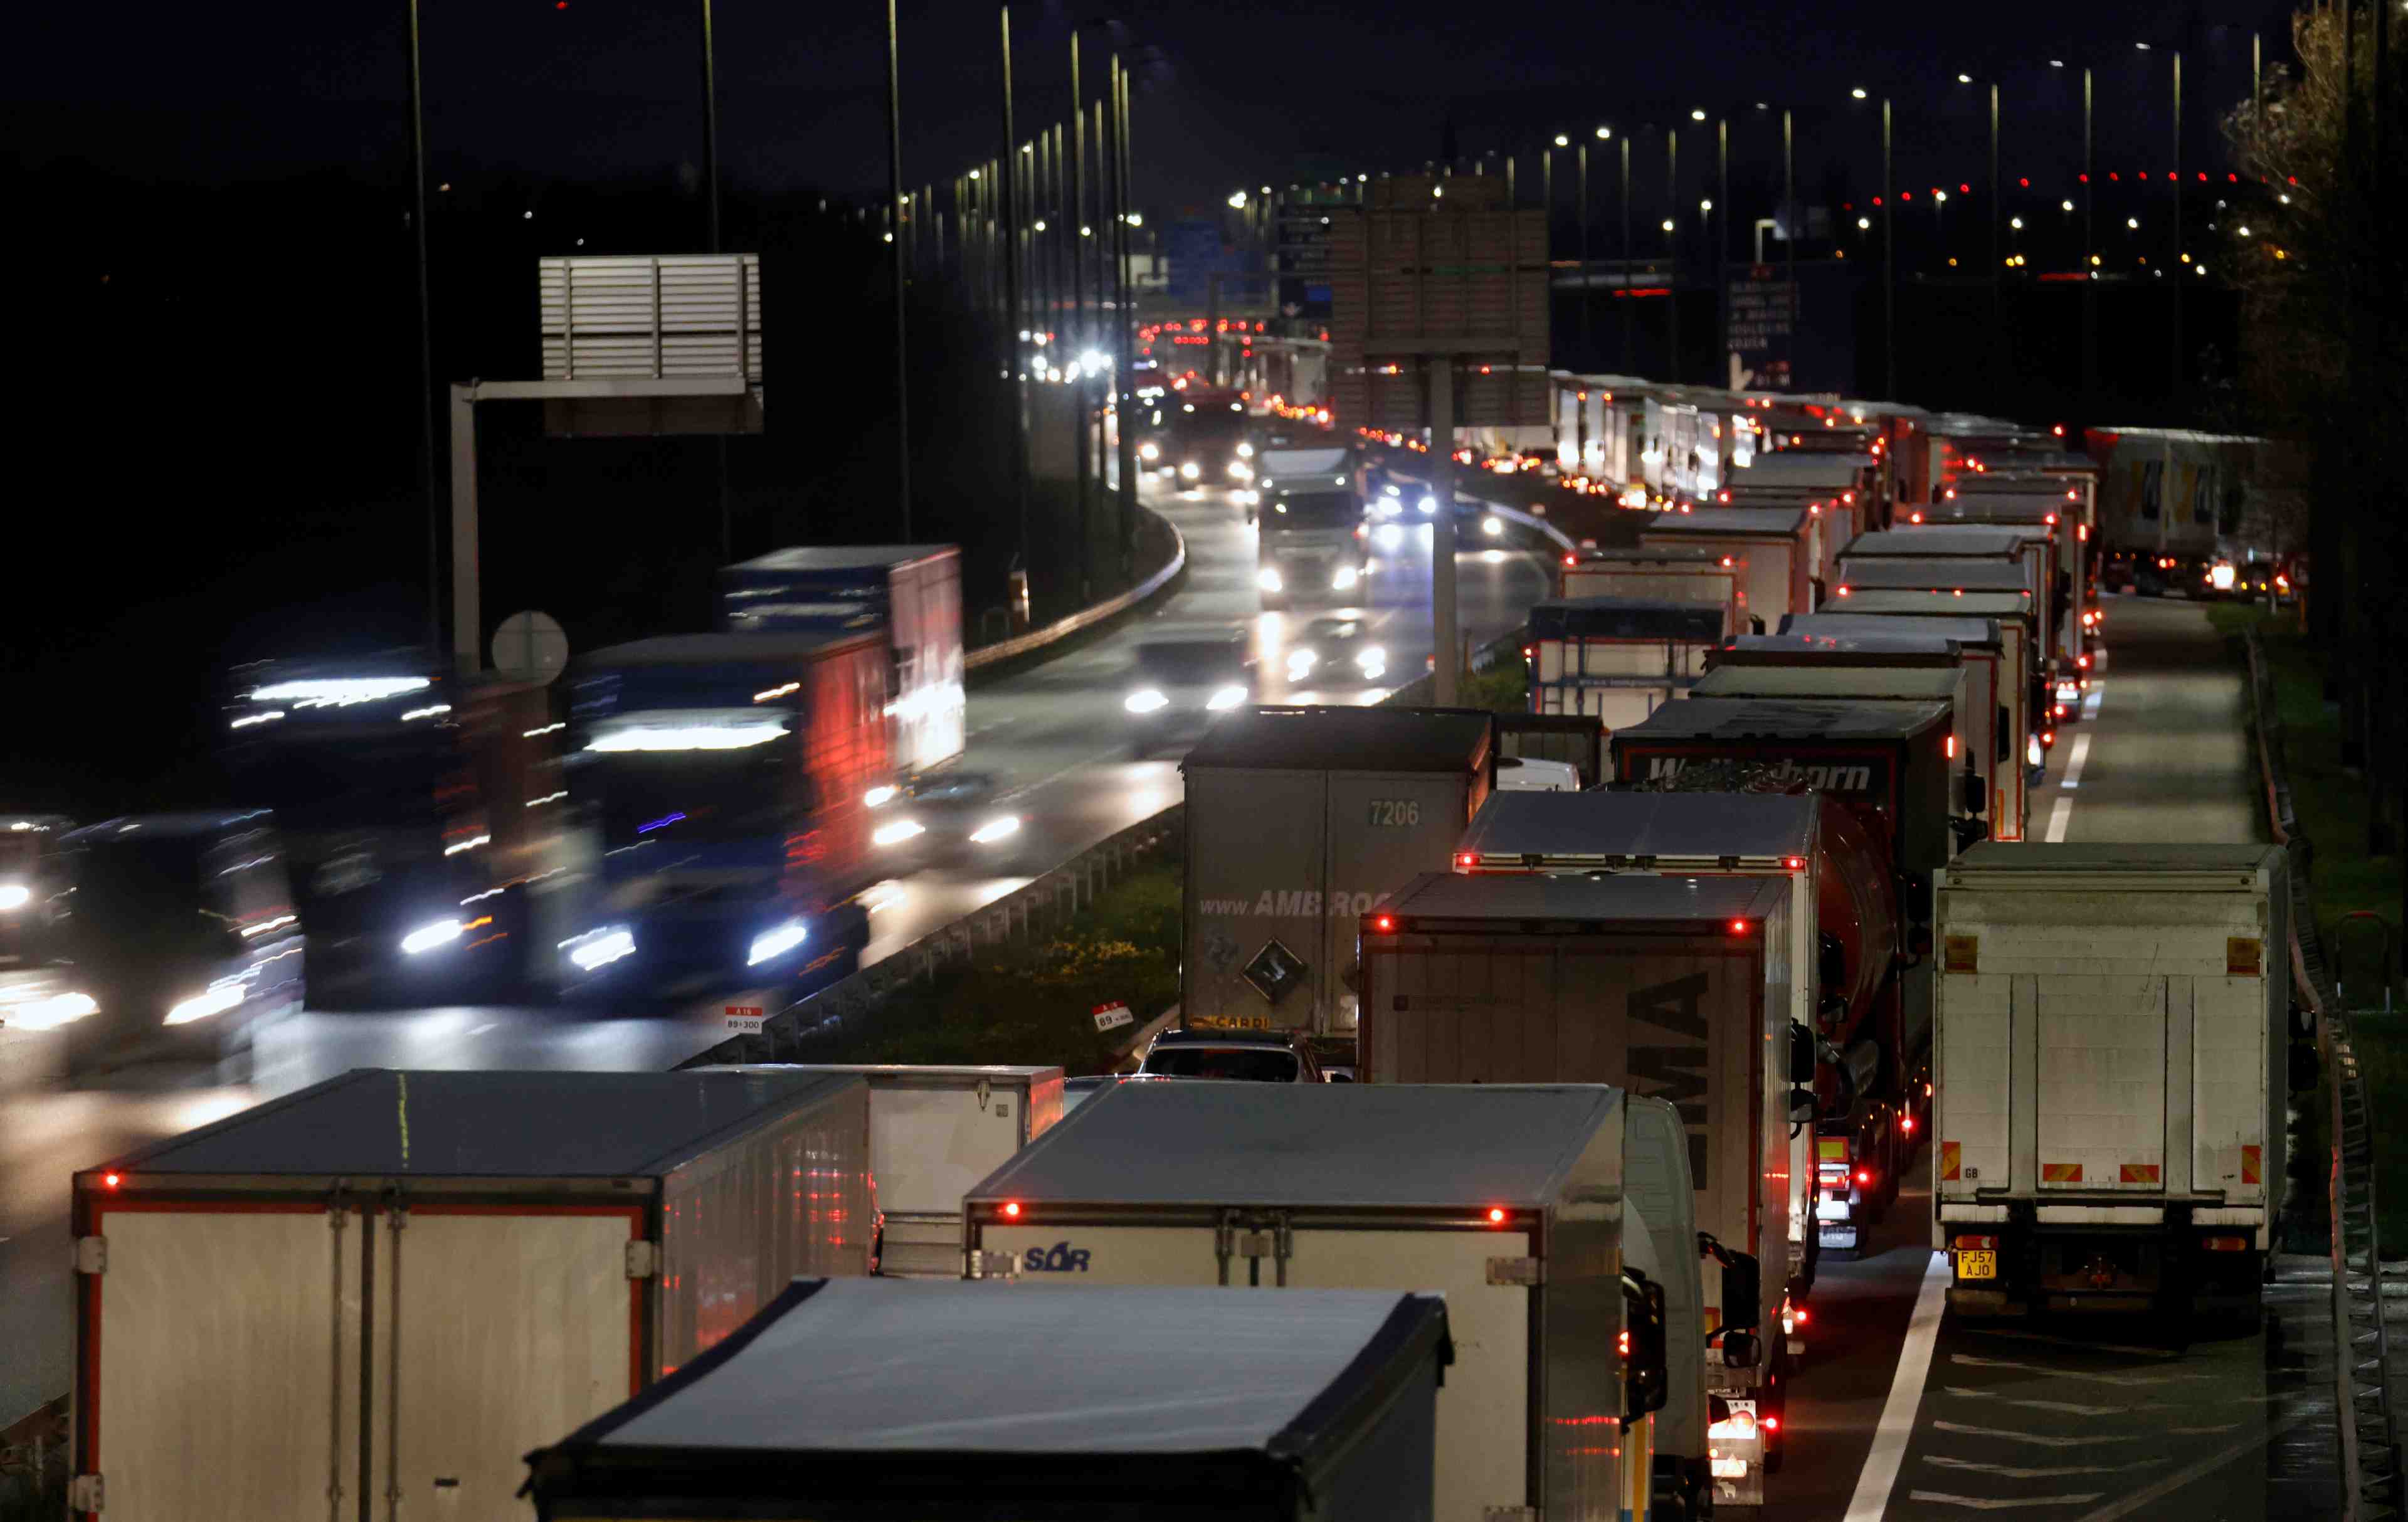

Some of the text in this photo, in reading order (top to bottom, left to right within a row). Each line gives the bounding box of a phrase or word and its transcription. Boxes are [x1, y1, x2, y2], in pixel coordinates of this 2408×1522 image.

[1371, 801, 1418, 825] 7206
[1965, 1168, 1978, 1178] GB
[1962, 1252, 1993, 1263] FJ57
